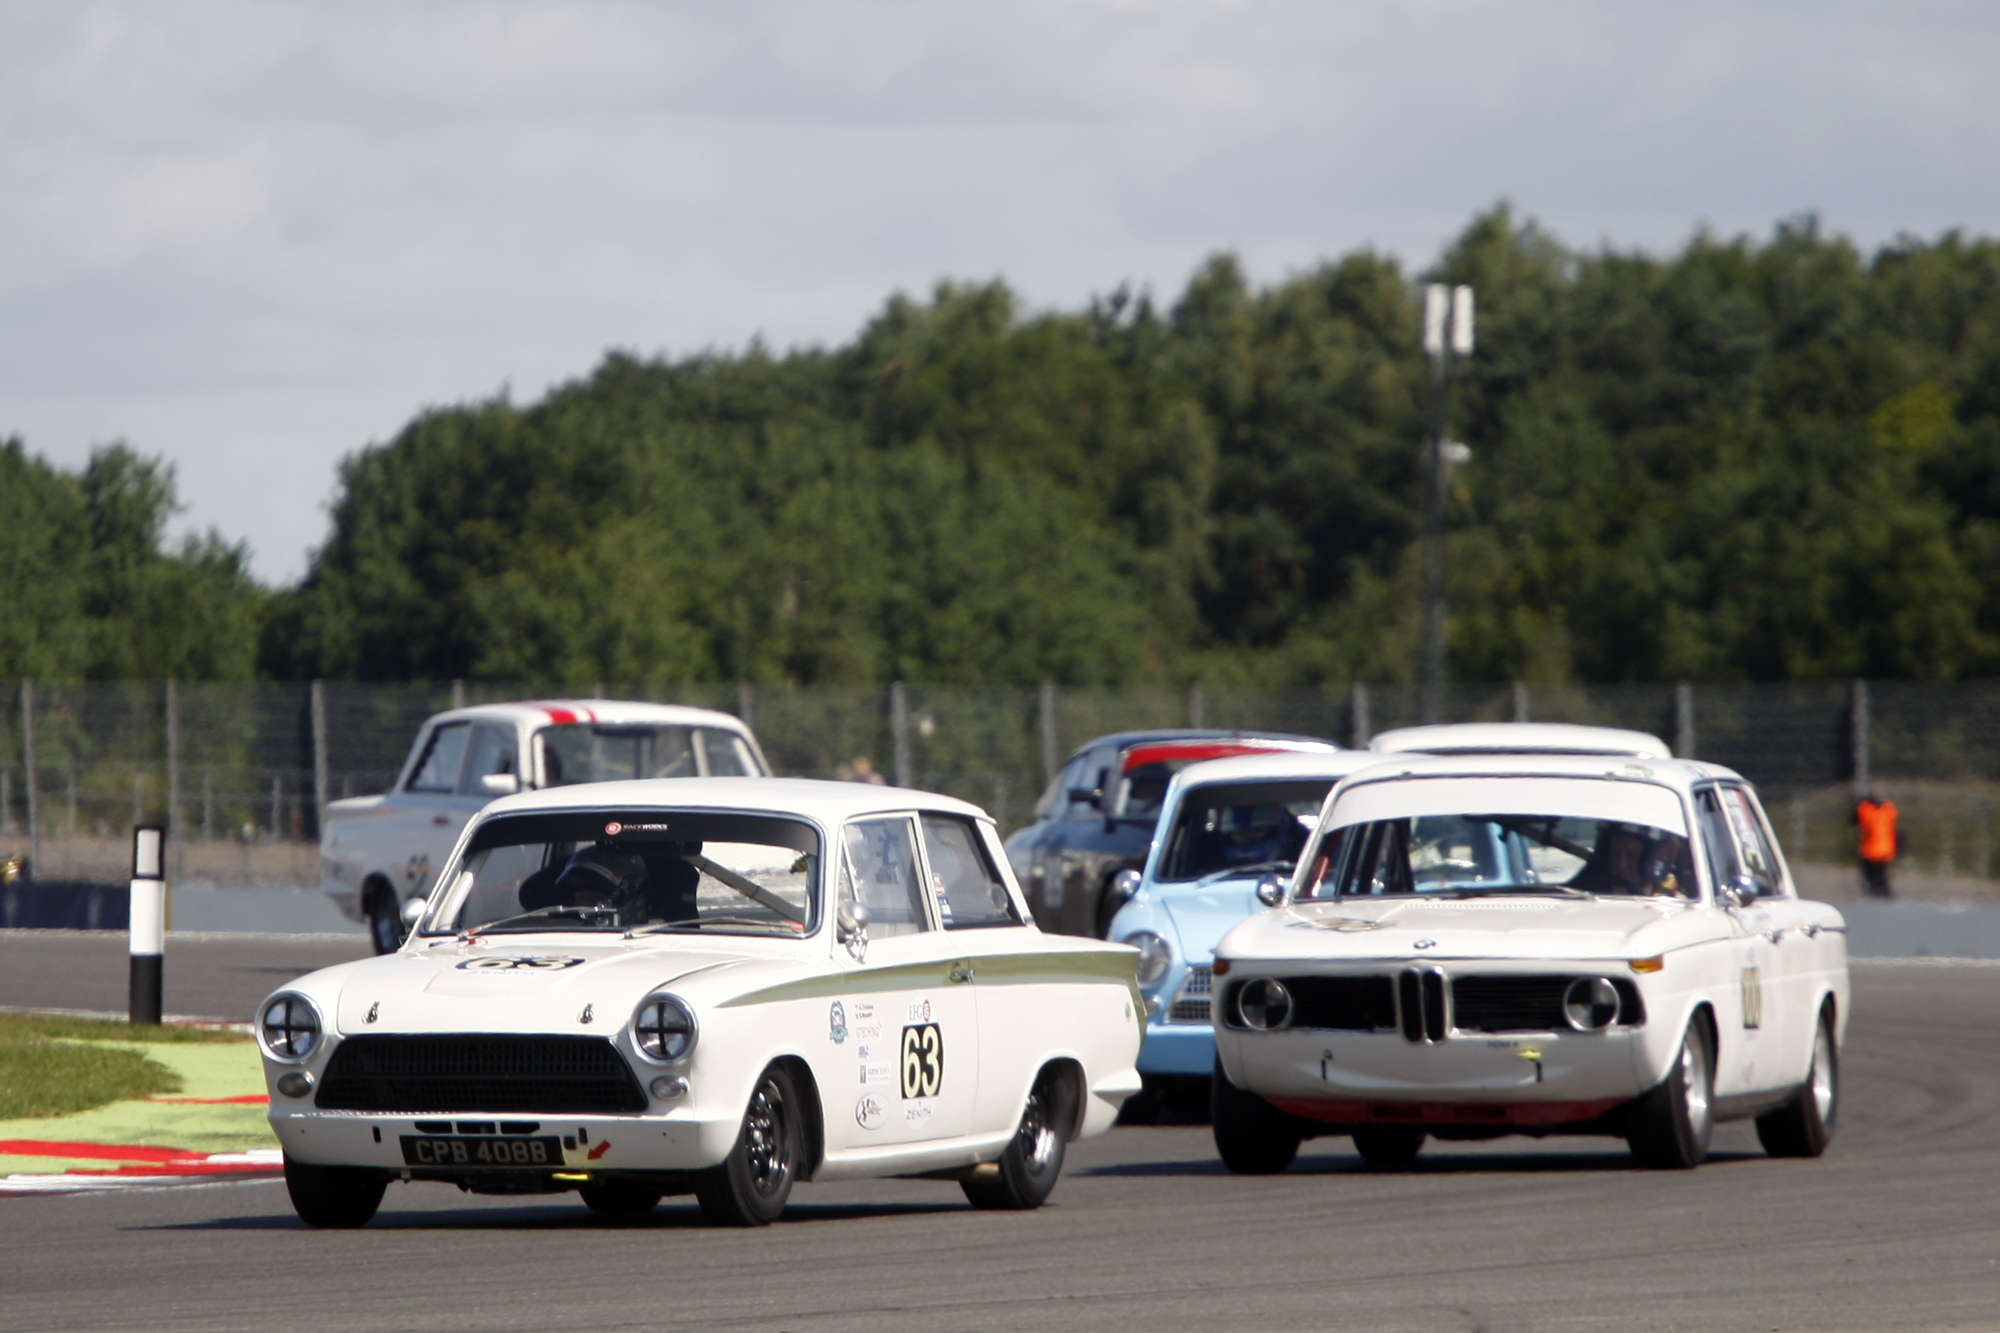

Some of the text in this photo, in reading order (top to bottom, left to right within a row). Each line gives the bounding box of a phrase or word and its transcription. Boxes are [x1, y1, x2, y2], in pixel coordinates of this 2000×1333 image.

[465, 957, 574, 970] 63
[903, 1025, 940, 1098] 63
[416, 1141, 548, 1163] CPB 408B
